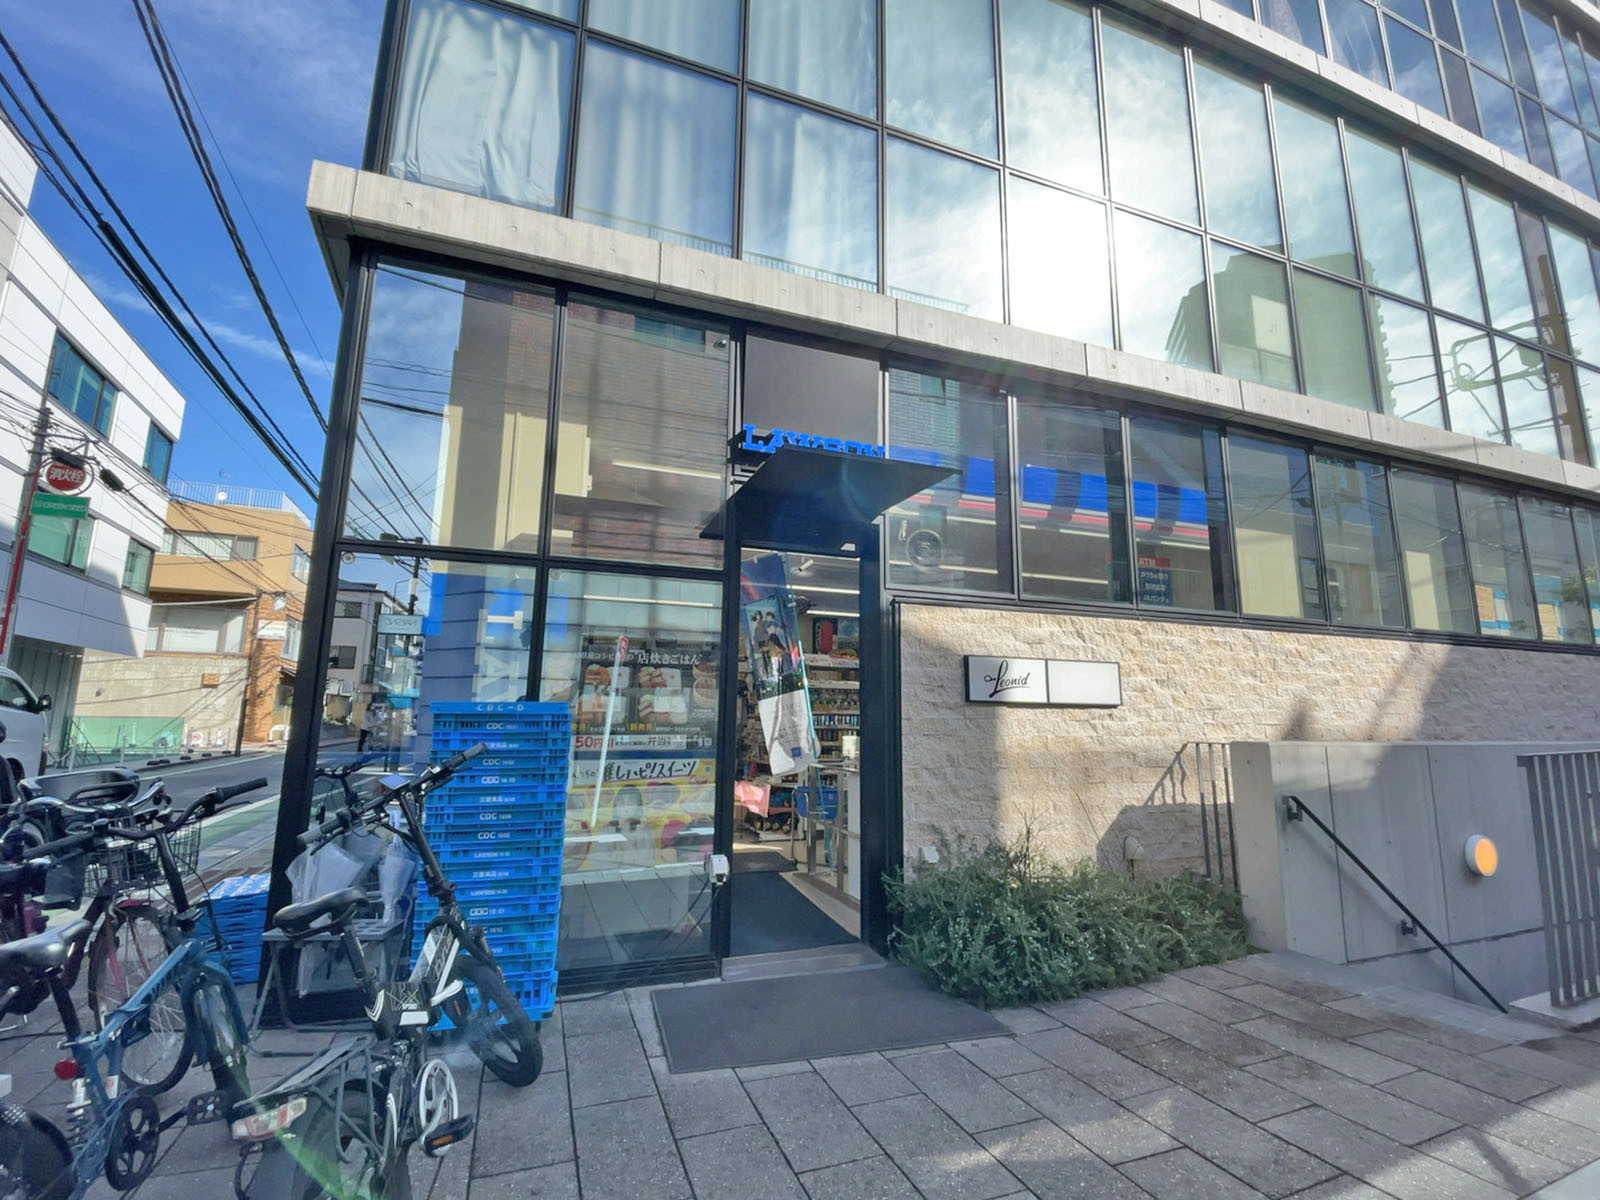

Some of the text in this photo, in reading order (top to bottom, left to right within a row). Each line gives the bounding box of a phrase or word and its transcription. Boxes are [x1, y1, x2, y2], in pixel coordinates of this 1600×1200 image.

[49, 467, 85, 483] 消火栓
[1139, 558, 1155, 567] ATM
[984, 659, 1031, 698] Leonid
